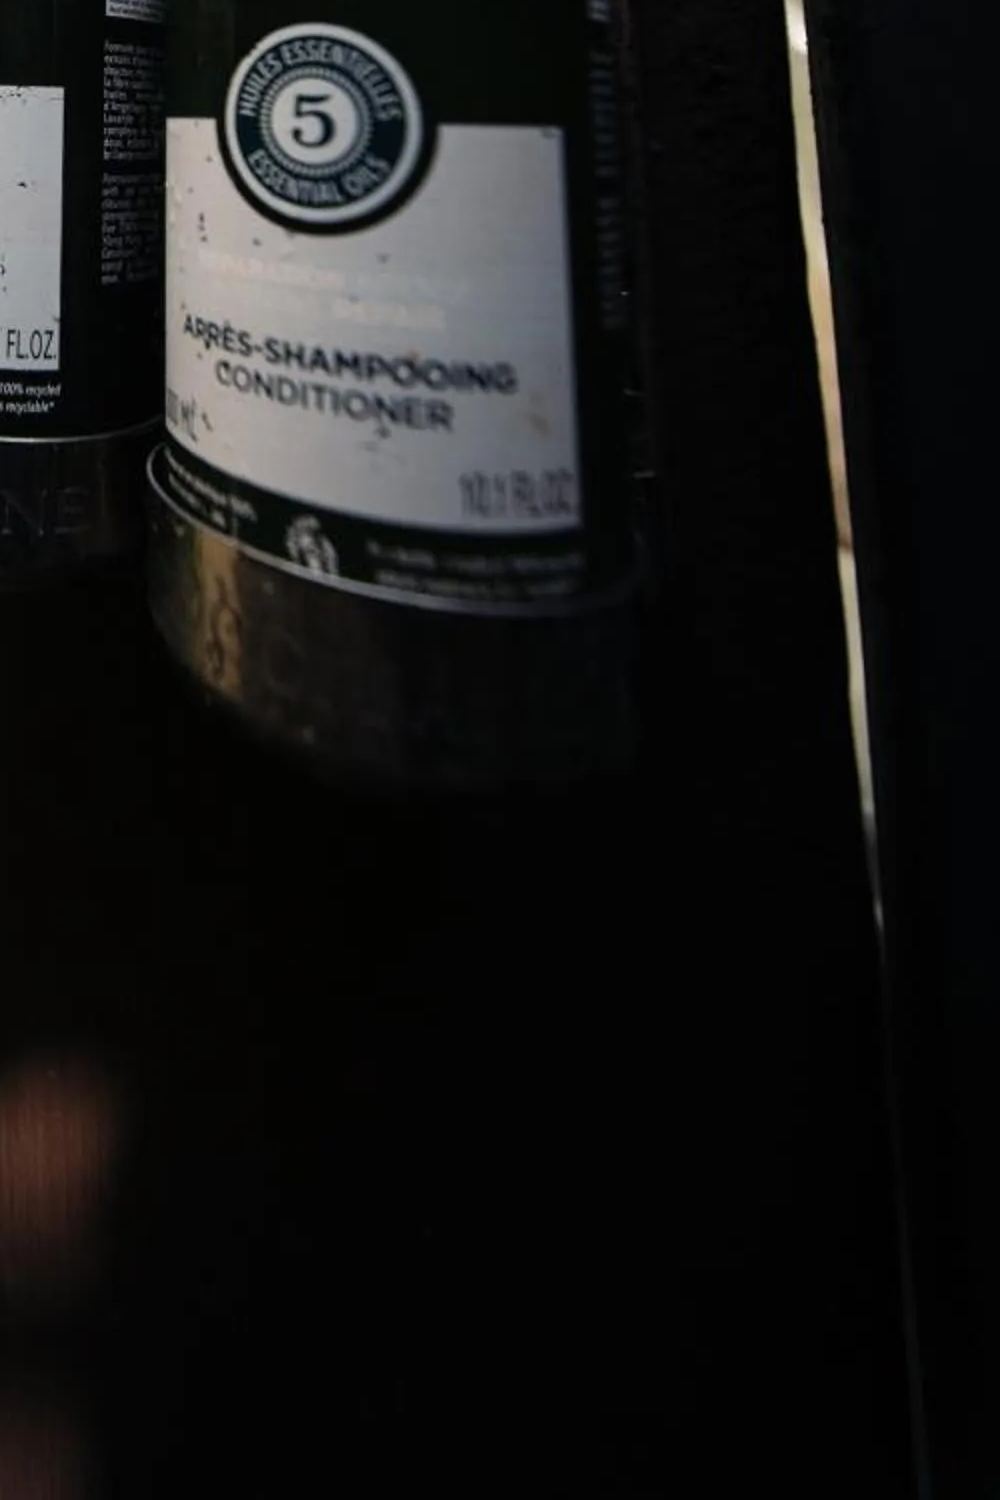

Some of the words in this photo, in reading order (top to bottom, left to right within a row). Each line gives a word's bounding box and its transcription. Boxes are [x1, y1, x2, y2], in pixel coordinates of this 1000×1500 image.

[238, 52, 284, 118] HUILES
[291, 92, 336, 148] 5
[247, 148, 346, 203] ESSENTIAL
[340, 153, 393, 197] OILS
[183, 312, 520, 396] APRÈS-SHAMPOOING
[214, 359, 456, 433] CONDITIONER
